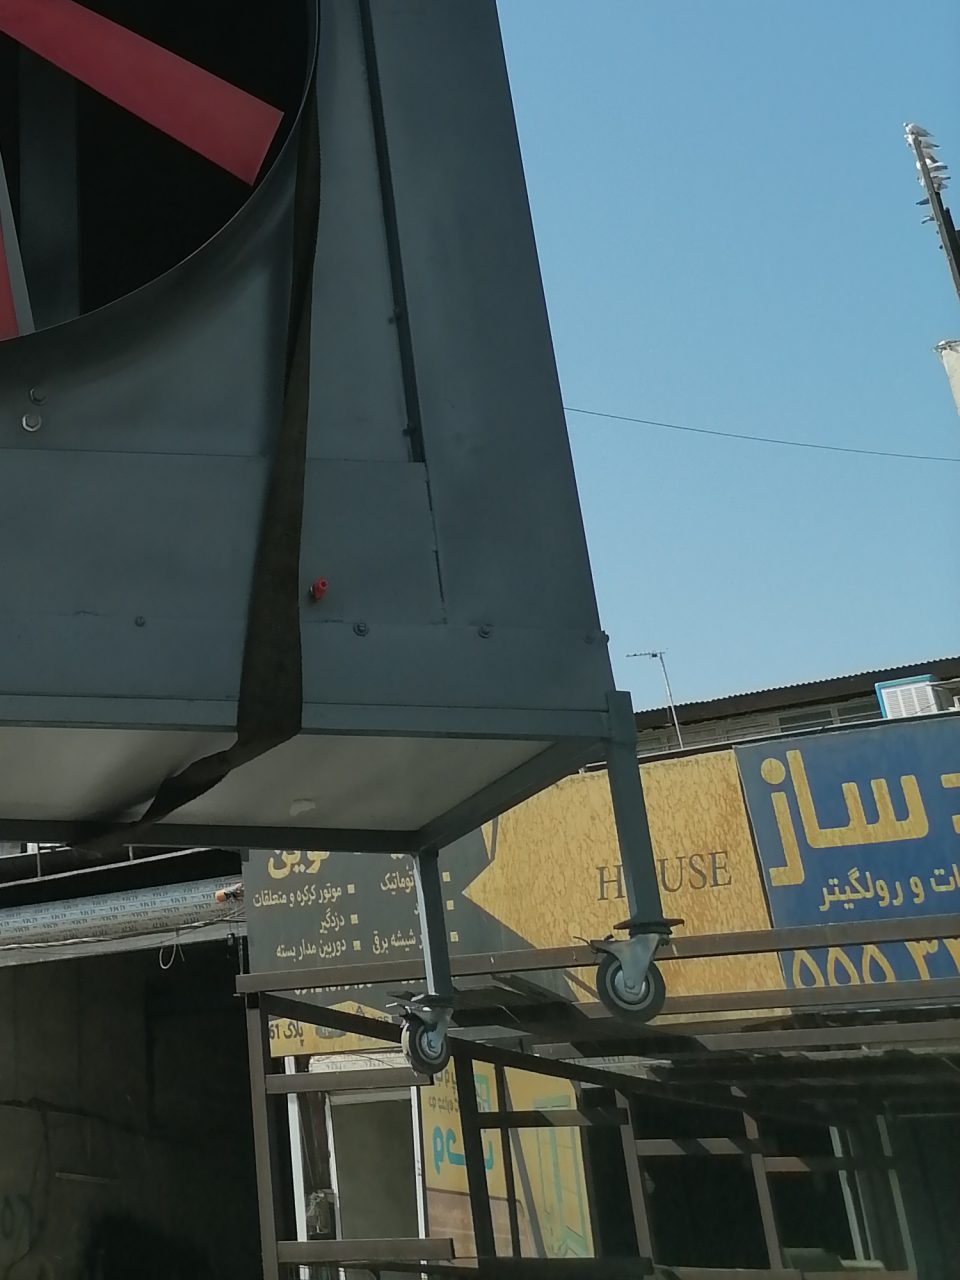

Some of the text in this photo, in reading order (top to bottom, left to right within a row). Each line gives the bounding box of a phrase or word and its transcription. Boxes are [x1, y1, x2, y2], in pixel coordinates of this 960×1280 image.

[760, 750, 929, 886] ساز
[380, 868, 415, 895] توماتیک
[596, 851, 732, 901] HUSE
[819, 867, 904, 911] رولگیتر
[909, 876, 925, 903] و
[253, 883, 342, 908] موتور کرکره و متعلقات
[320, 907, 345, 933] دزدگیر
[276, 938, 346, 962] دوربین مدار بسته
[390, 928, 416, 951] شیشه
